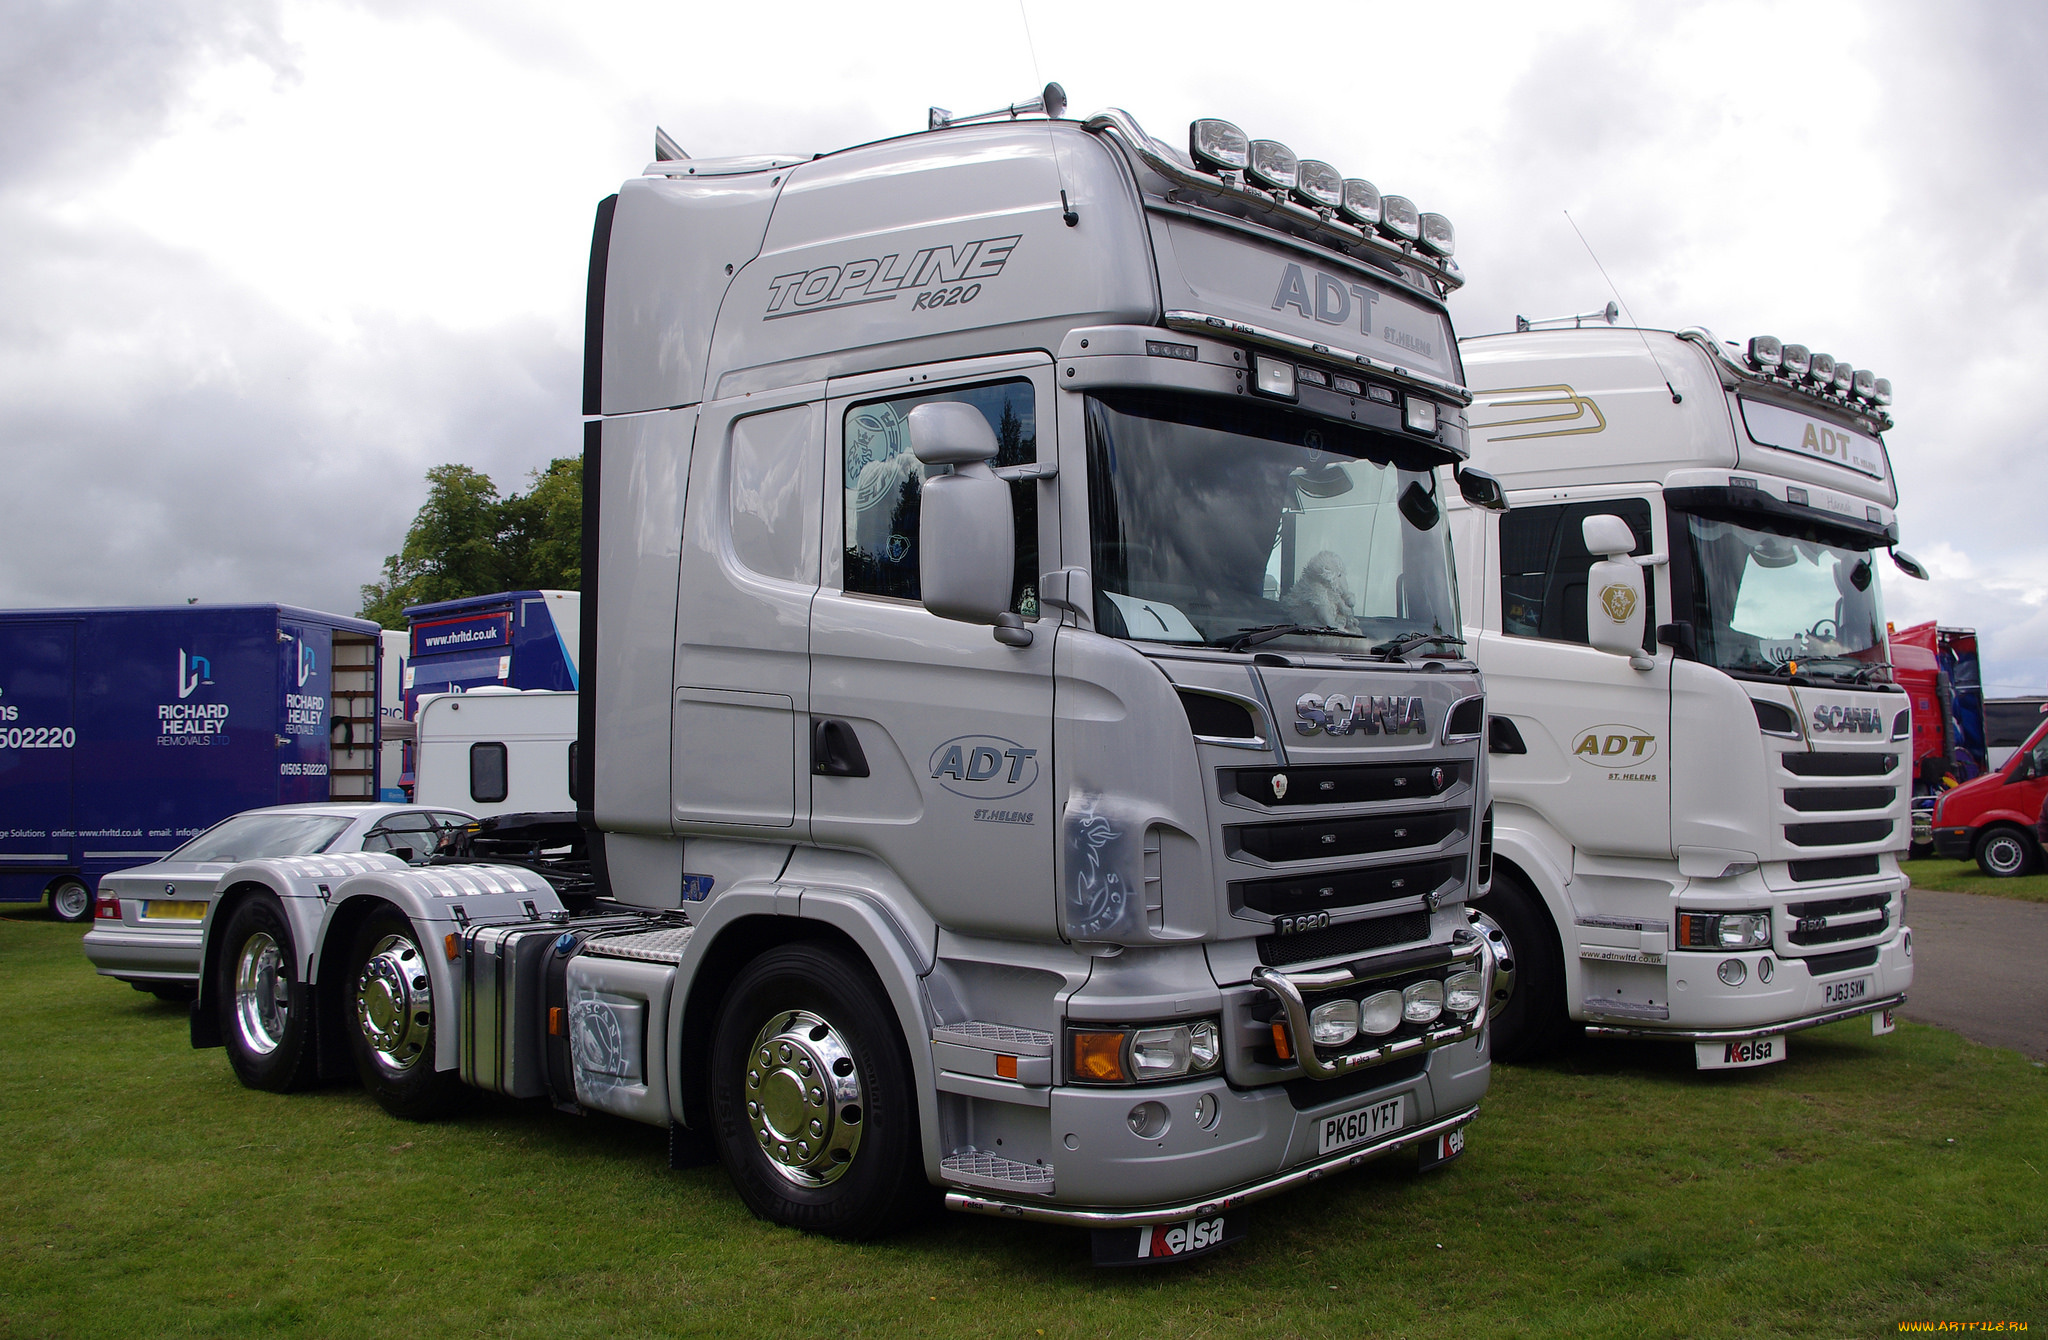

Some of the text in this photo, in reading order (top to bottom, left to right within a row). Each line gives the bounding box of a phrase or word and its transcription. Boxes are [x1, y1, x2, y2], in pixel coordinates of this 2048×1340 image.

[766, 234, 1023, 312] TOPLINE
[912, 283, 982, 312] R620
[1272, 262, 1380, 336] ADT
[1801, 422, 1850, 460] ADT
[425, 626, 497, 647] www.rhrltd.co.uk
[158, 704, 230, 719] RICHARD
[285, 693, 325, 711] RICHARD
[287, 709, 322, 725] HEALEY
[1294, 693, 1428, 737] SCANIA
[1812, 704, 1883, 734] SCANIA
[162, 719, 225, 735] HEALEY
[285, 723, 315, 736] REMOVALS
[157, 735, 231, 746] REMOVALS LTD
[1573, 734, 1656, 757] ADT
[280, 763, 328, 776] 01505 502220
[931, 745, 1037, 784] ADT
[10, 828, 46, 838] Solutions
[78, 827, 143, 838] www.rhrltd.co.uk
[1295, 911, 1330, 933] 620
[1580, 950, 1662, 964] www.adtnwltd.co.uk
[1826, 984, 1850, 1003] PJ63
[1724, 1040, 1773, 1063] Kelsa
[1326, 1100, 1399, 1148] PK60 YFT
[1138, 1217, 1225, 1258] Kelsa
